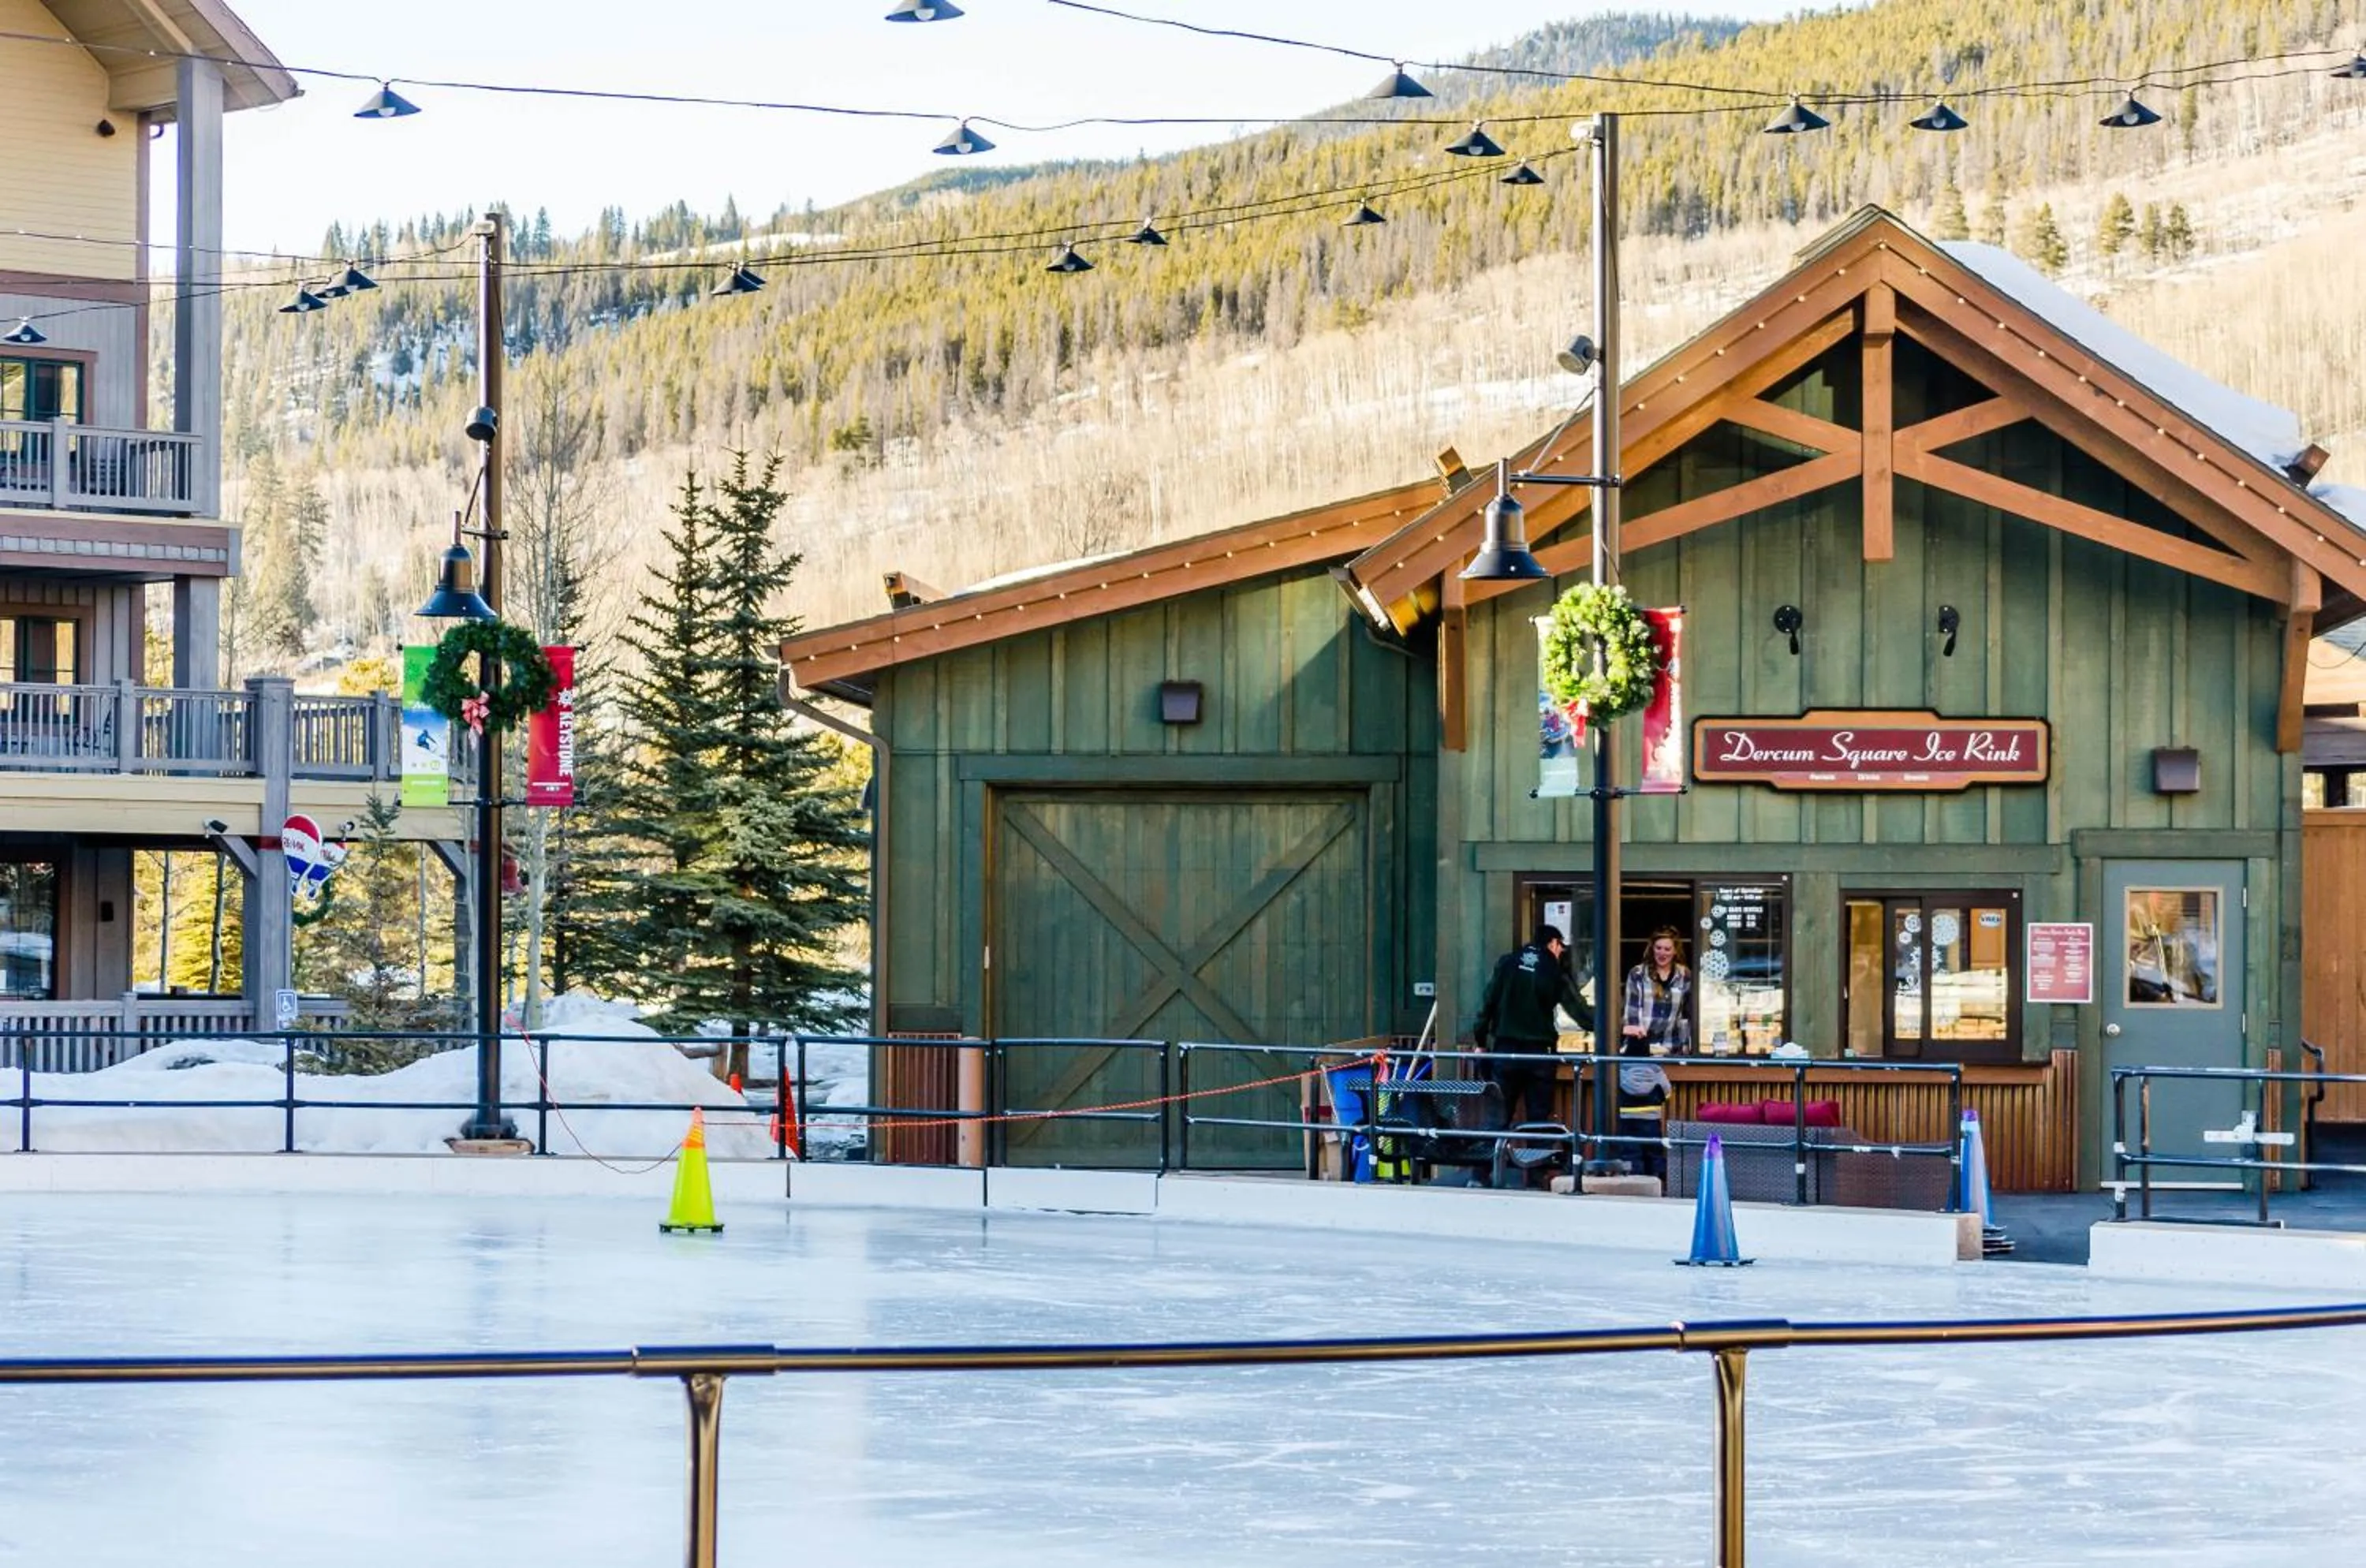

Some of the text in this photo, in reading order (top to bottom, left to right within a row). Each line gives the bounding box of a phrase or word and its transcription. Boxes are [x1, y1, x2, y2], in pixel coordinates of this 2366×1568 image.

[558, 711, 574, 777] KEYSTONE
[1719, 731, 2021, 769] Dercum Square Ice Rink
